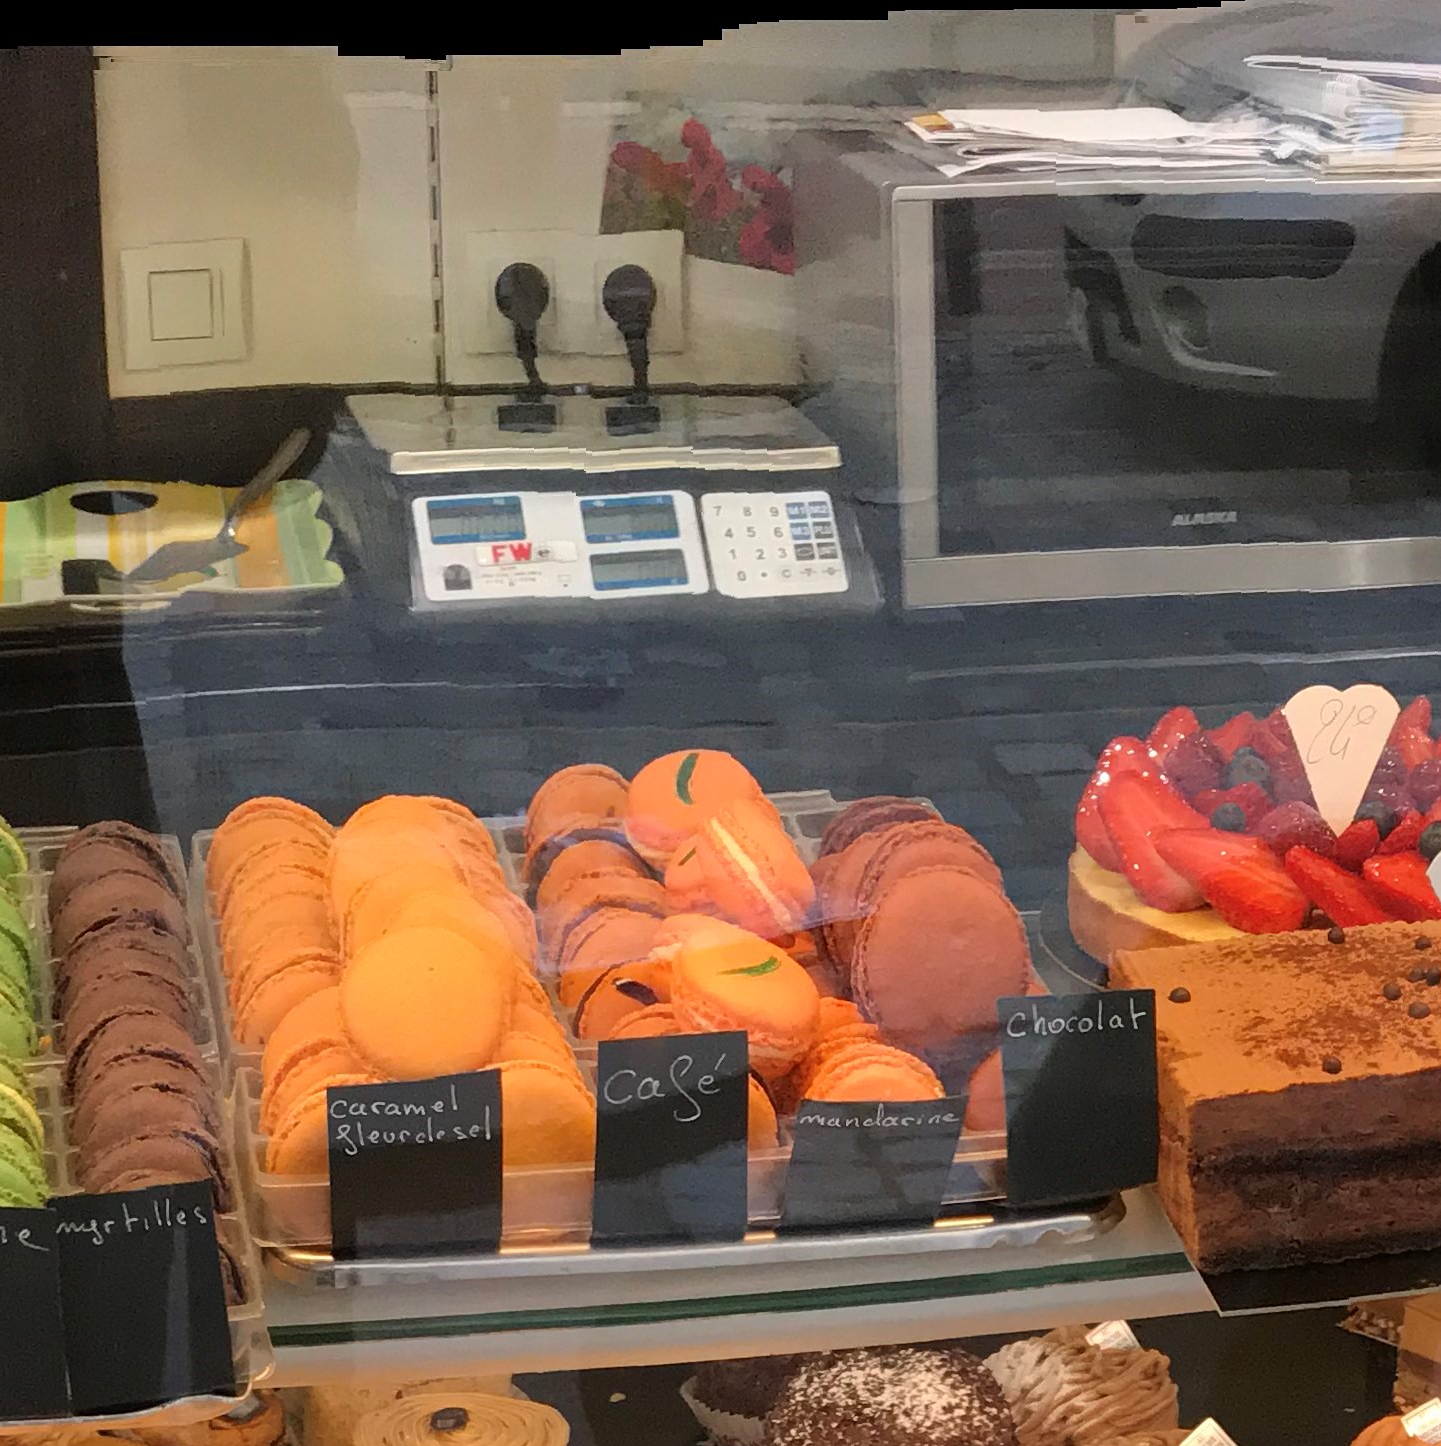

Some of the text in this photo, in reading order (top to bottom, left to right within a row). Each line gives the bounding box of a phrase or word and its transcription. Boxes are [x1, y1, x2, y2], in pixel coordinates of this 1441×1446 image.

[714, 506, 779, 517] 7 8 9
[725, 526, 783, 538] 4 5 6
[492, 542, 533, 563] FW
[729, 547, 787, 560] 1 2 3
[737, 571, 747, 582] 0
